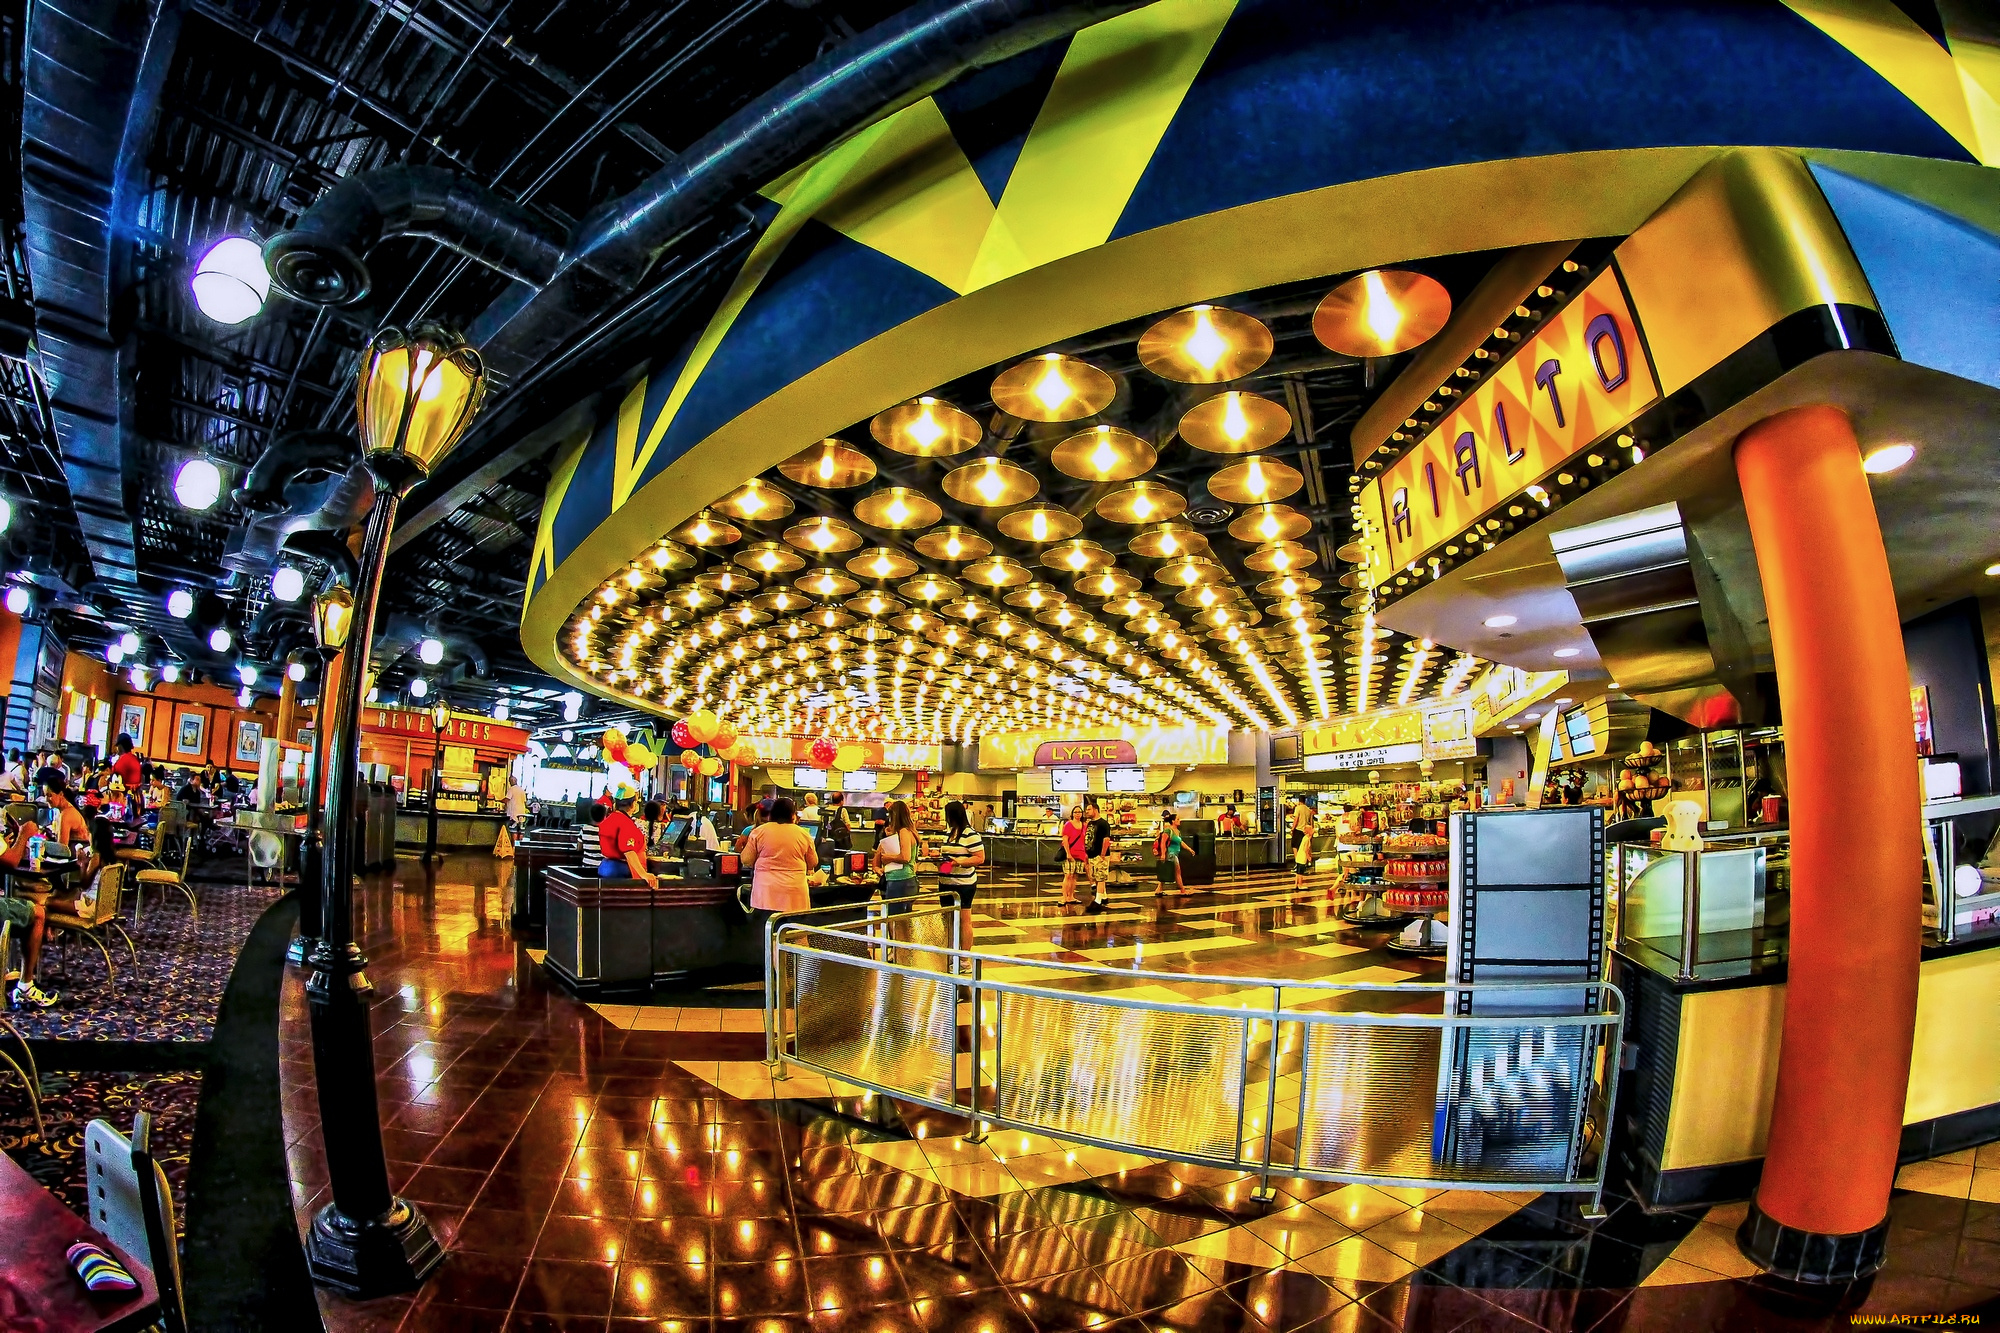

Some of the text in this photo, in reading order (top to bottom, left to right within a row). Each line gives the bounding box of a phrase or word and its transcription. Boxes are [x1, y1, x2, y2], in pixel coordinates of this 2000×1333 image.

[1392, 313, 1627, 544] RIALTO
[378, 712, 490, 740] BEVEAGES
[1052, 745, 1118, 760] LYRIC
